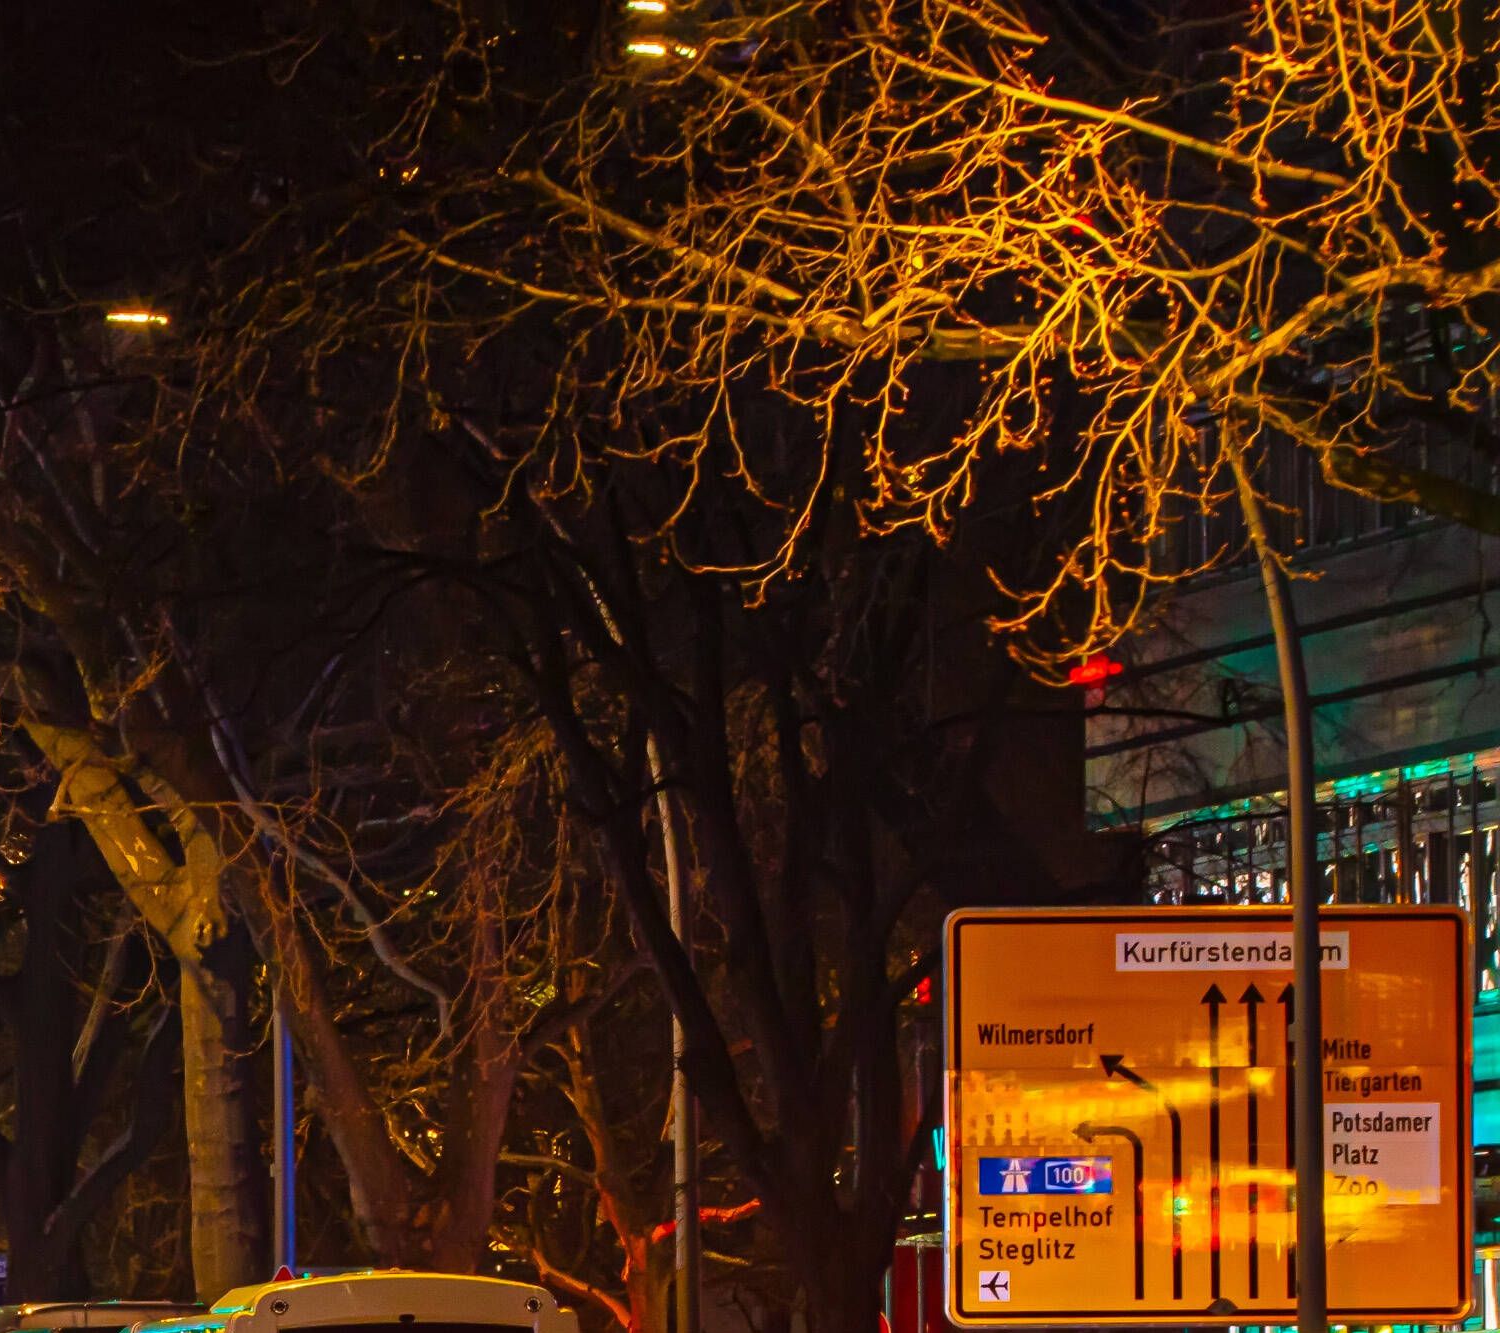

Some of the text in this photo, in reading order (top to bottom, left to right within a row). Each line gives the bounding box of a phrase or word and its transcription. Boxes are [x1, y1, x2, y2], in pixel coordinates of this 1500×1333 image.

[1123, 940, 1342, 963] Kurfürstendam
[977, 1023, 1094, 1046] Wilmersdorf
[1323, 1039, 1371, 1060] Mitte
[1332, 1111, 1432, 1133] Potsdamer
[1332, 1143, 1379, 1165] Platz
[1053, 1167, 1084, 1184] 100
[978, 1205, 1113, 1233] Tempelhof
[979, 1238, 1076, 1266] Steglitz
